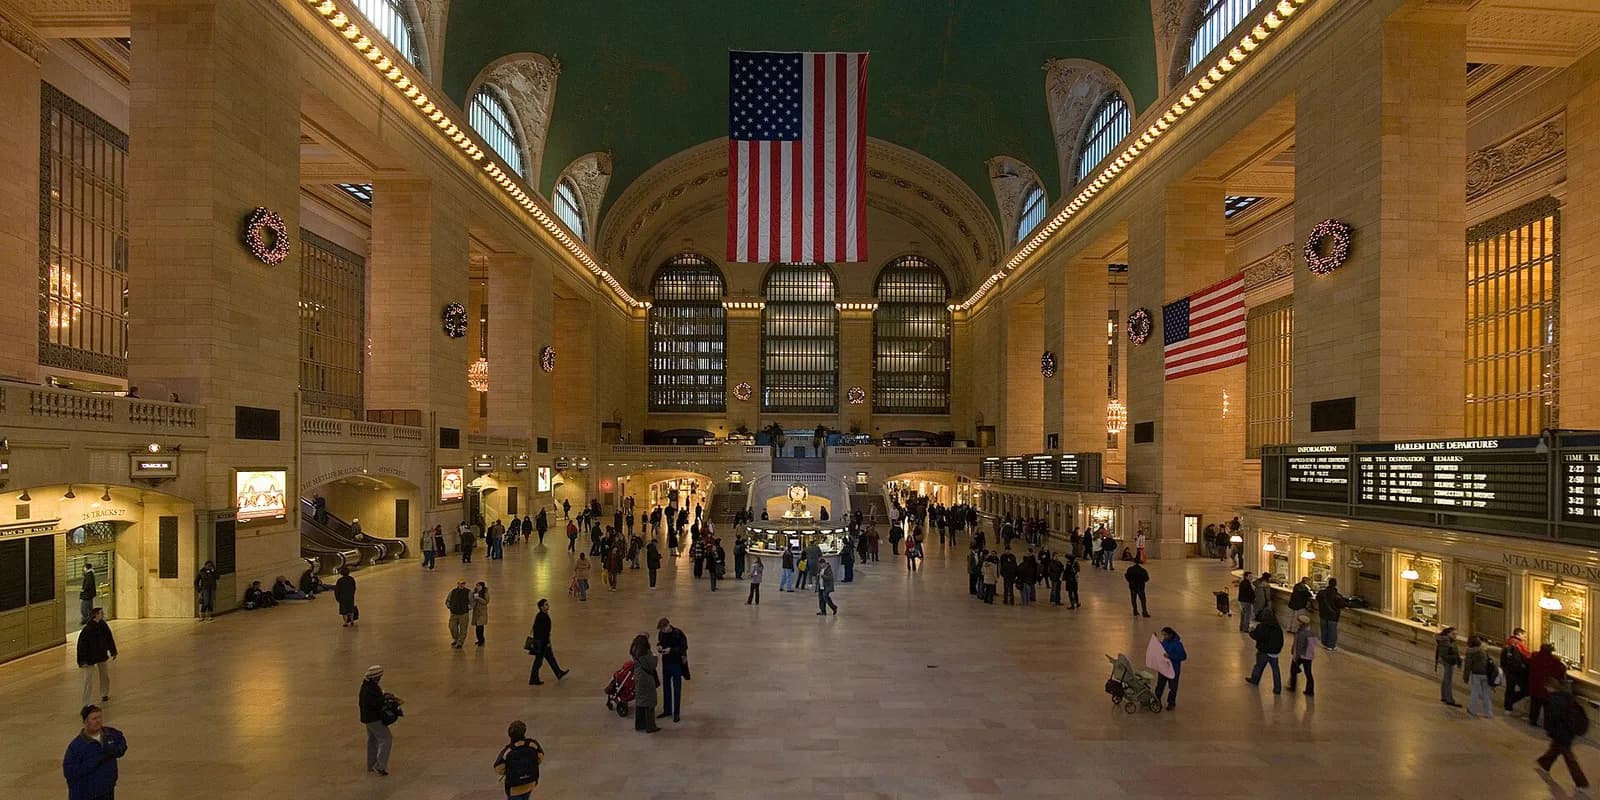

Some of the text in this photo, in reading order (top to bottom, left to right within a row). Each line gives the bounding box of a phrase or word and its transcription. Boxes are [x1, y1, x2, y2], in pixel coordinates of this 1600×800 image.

[1394, 440, 1499, 451] HARLEM LINE DEPARTURES
[1568, 465, 1585, 473] 2:23
[91, 508, 117, 519] TRACKS
[1502, 553, 1529, 567] MTA
